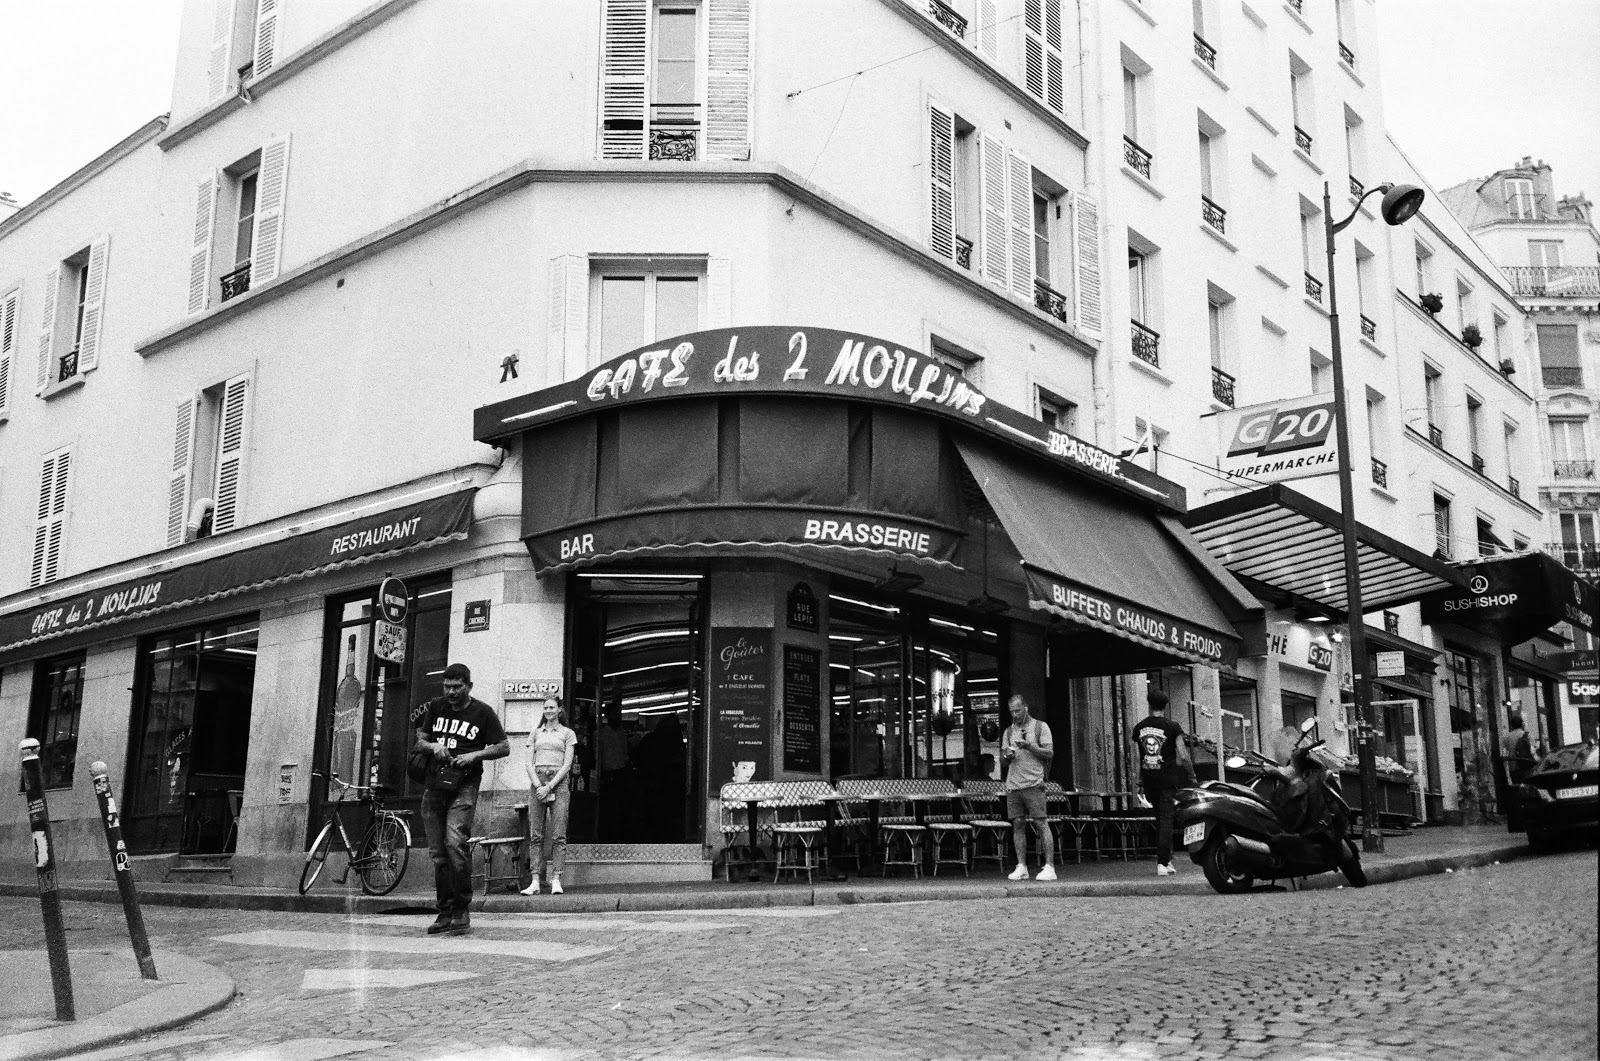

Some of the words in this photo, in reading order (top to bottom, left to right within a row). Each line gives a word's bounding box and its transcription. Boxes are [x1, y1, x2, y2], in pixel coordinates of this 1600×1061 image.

[714, 335, 760, 383] des
[783, 331, 808, 382] 2
[824, 339, 986, 416] MOULINS
[1239, 408, 1330, 444] G20
[1048, 430, 1121, 478] BRASSERIE
[1226, 450, 1336, 480] SUPERMARCHÉ
[330, 517, 422, 556] RESTAURANT
[560, 533, 595, 560] BAR
[804, 519, 931, 554] BRASSERIE
[65, 604, 82, 625] des
[83, 598, 94, 622] 2
[96, 581, 162, 618] MOULINS
[796, 602, 811, 613] RUE
[384, 624, 401, 636] SAUF
[793, 612, 814, 625] LEPIC
[1052, 584, 1112, 621] BUFFETS
[1117, 608, 1166, 640] CHAUDS
[1171, 626, 1179, 645] &
[1183, 631, 1222, 659] FROIDS
[1309, 644, 1332, 667] G20
[504, 682, 560, 693] RICARD
[789, 721, 814, 732] DESSERTS
